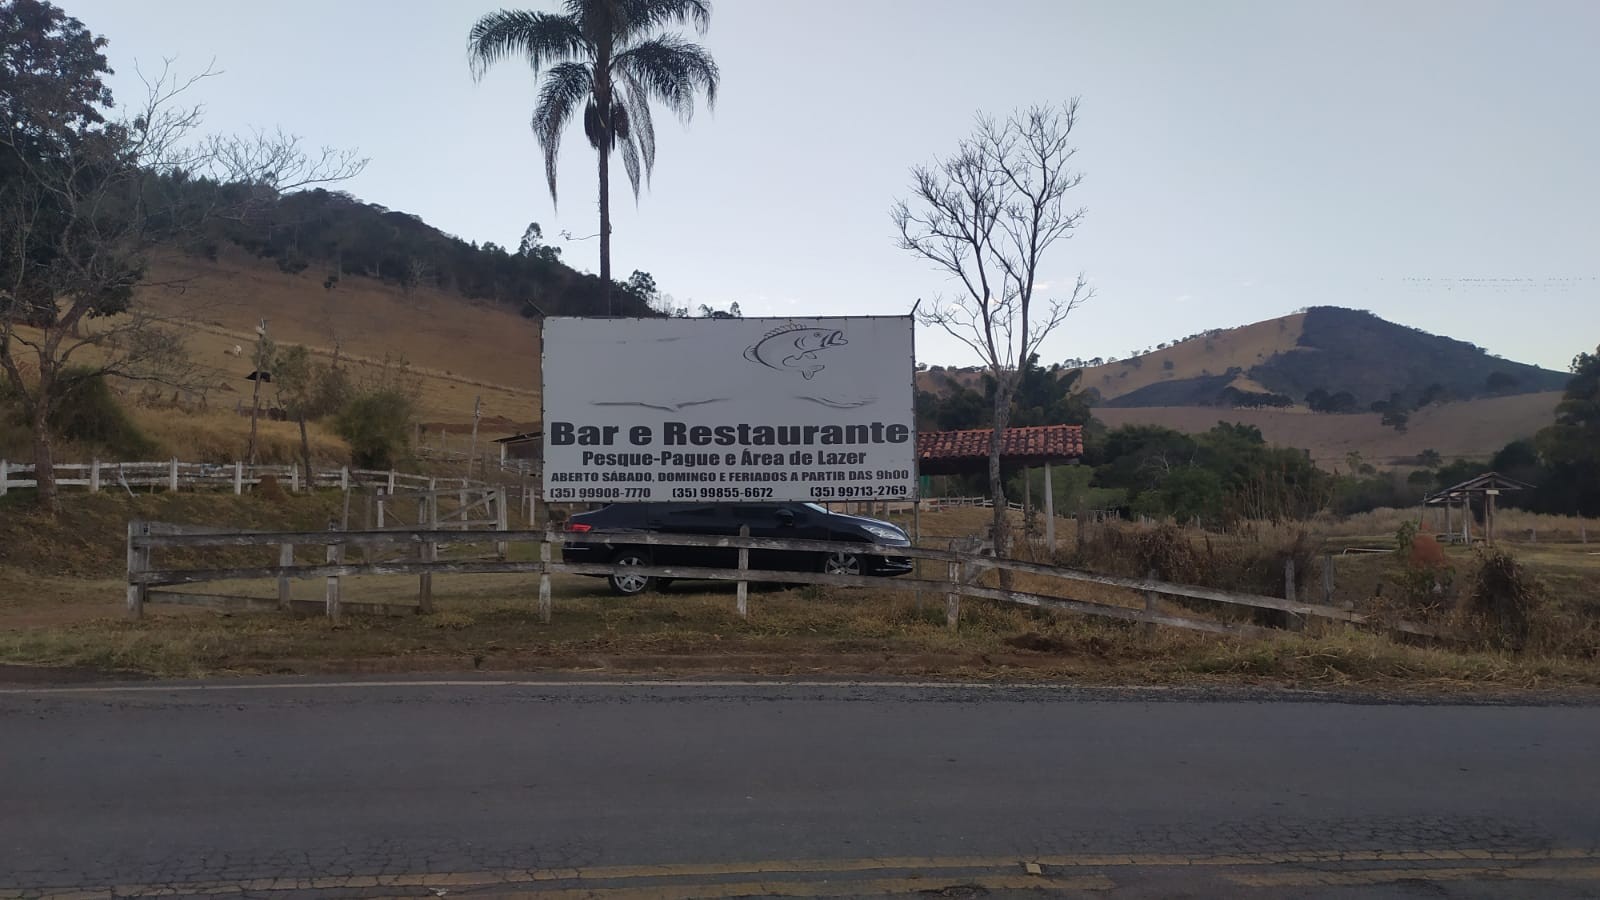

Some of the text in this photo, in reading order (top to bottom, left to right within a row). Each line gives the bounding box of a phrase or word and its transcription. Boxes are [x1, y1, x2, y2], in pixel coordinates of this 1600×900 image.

[551, 421, 908, 446] Bar e Restaurante
[583, 448, 866, 467] Pesque-Pague e Área de Lazer
[551, 470, 909, 483] ABERTO SÁBADO, DOMINGO E FERIADOS A PARTIR DAS 9h00
[550, 487, 651, 499] (35) 99908-7770
[672, 487, 774, 499] (35) 99855-6672
[810, 485, 907, 498] (35) 99713-2769
